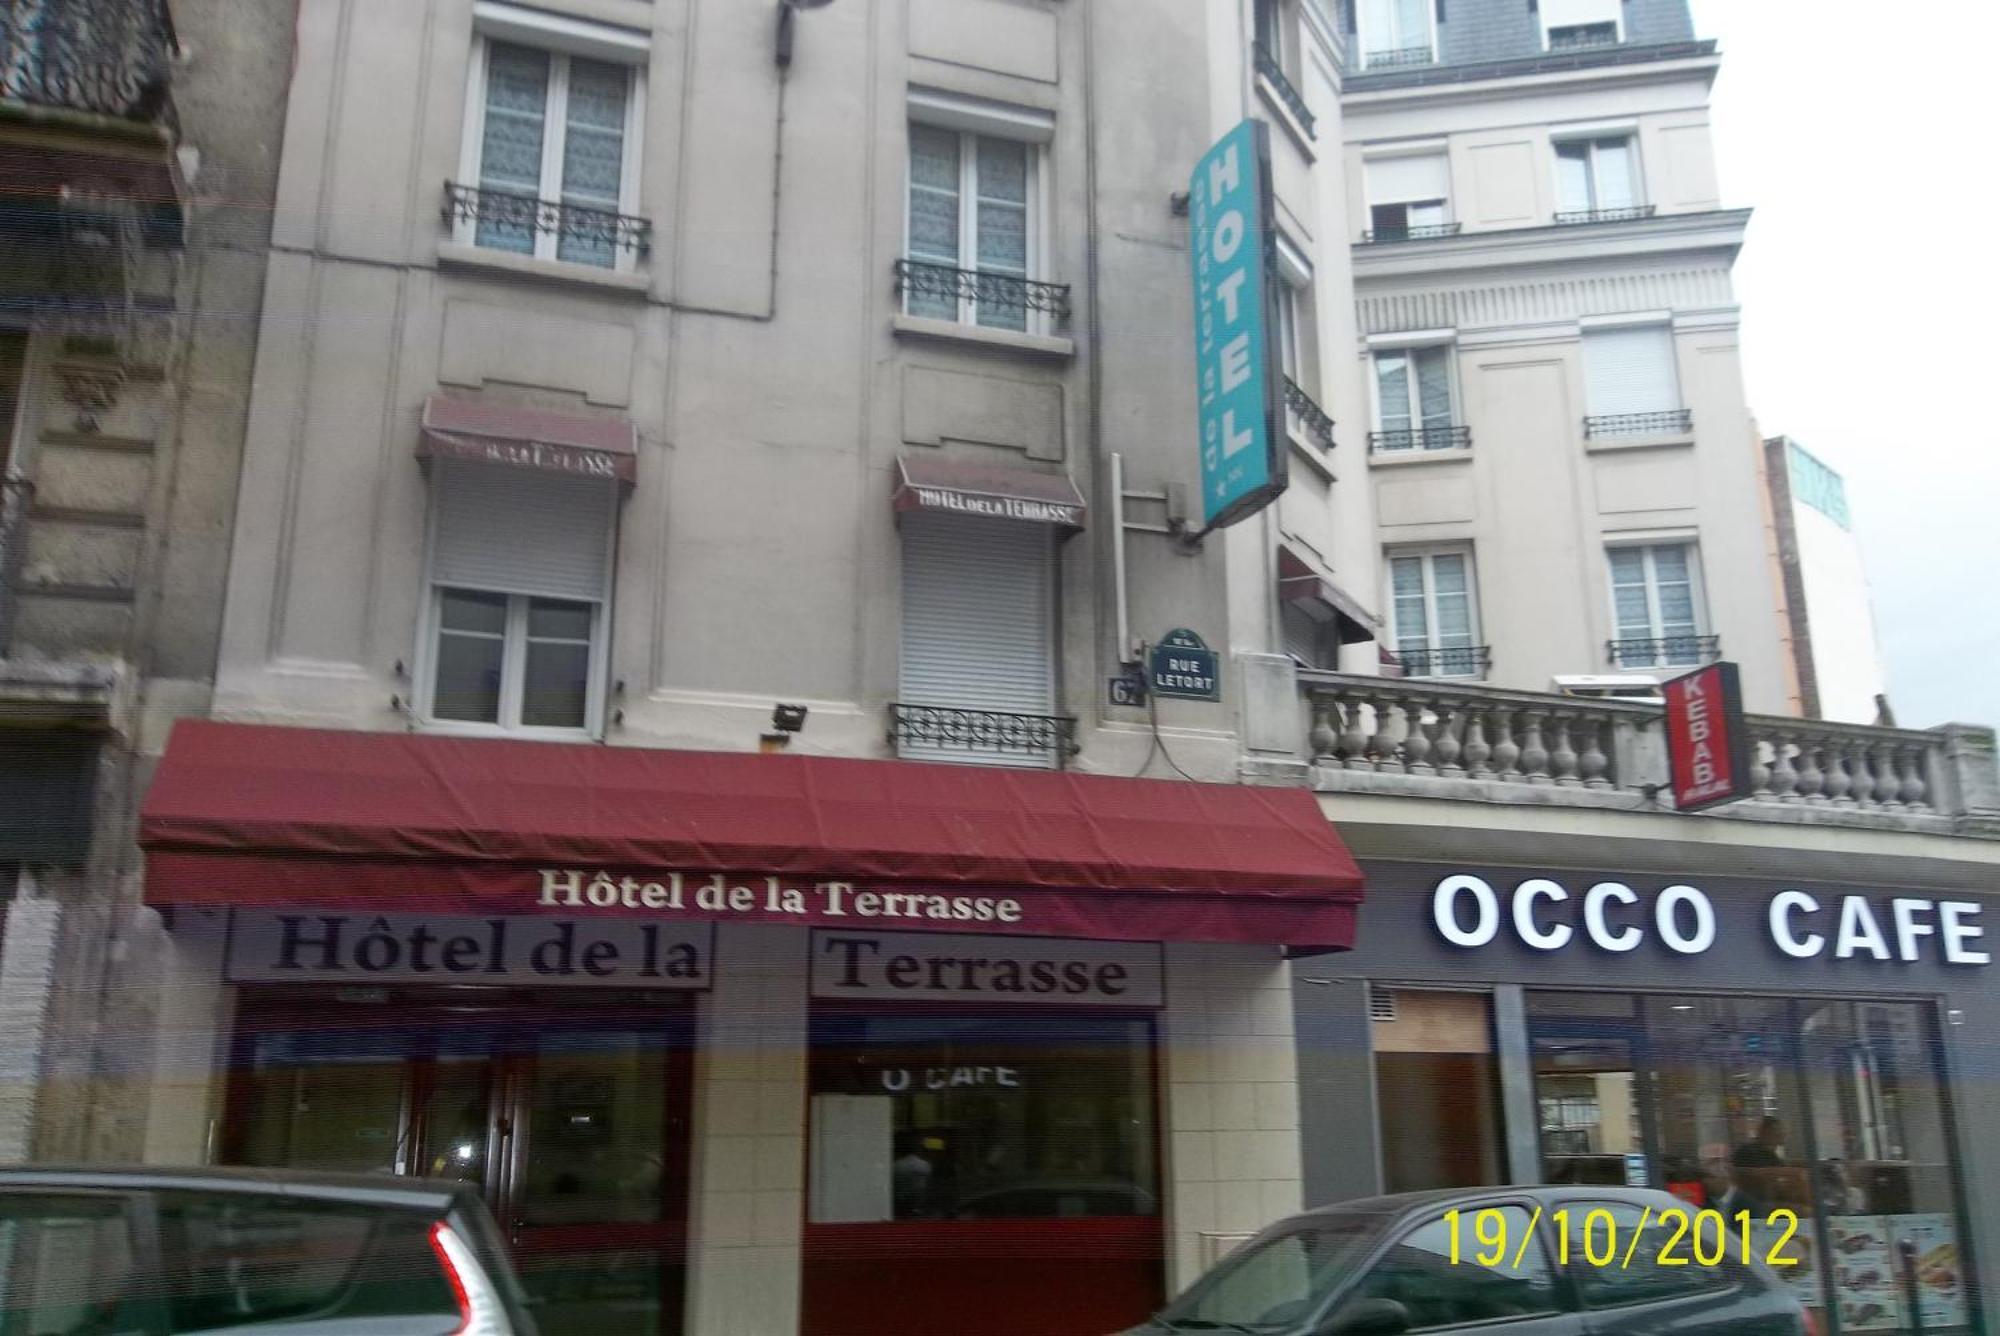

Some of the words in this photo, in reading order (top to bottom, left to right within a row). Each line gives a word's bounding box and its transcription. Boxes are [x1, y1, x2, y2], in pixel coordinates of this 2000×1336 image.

[1209, 143, 1252, 459] HOTEL
[1157, 674, 1213, 690] LETORT
[1169, 658, 1201, 673] RUE
[1683, 674, 1715, 785] KEBAB
[537, 868, 684, 910] Hôtel
[695, 874, 756, 913] de
[765, 876, 806, 915] la
[815, 881, 1023, 923] Terrasse
[1433, 873, 1717, 954] OCCO
[1768, 890, 1991, 965] CAFE
[272, 914, 508, 974] Hôtel
[529, 922, 620, 978] de
[638, 924, 699, 979] la
[825, 938, 1128, 996] Terrasse
